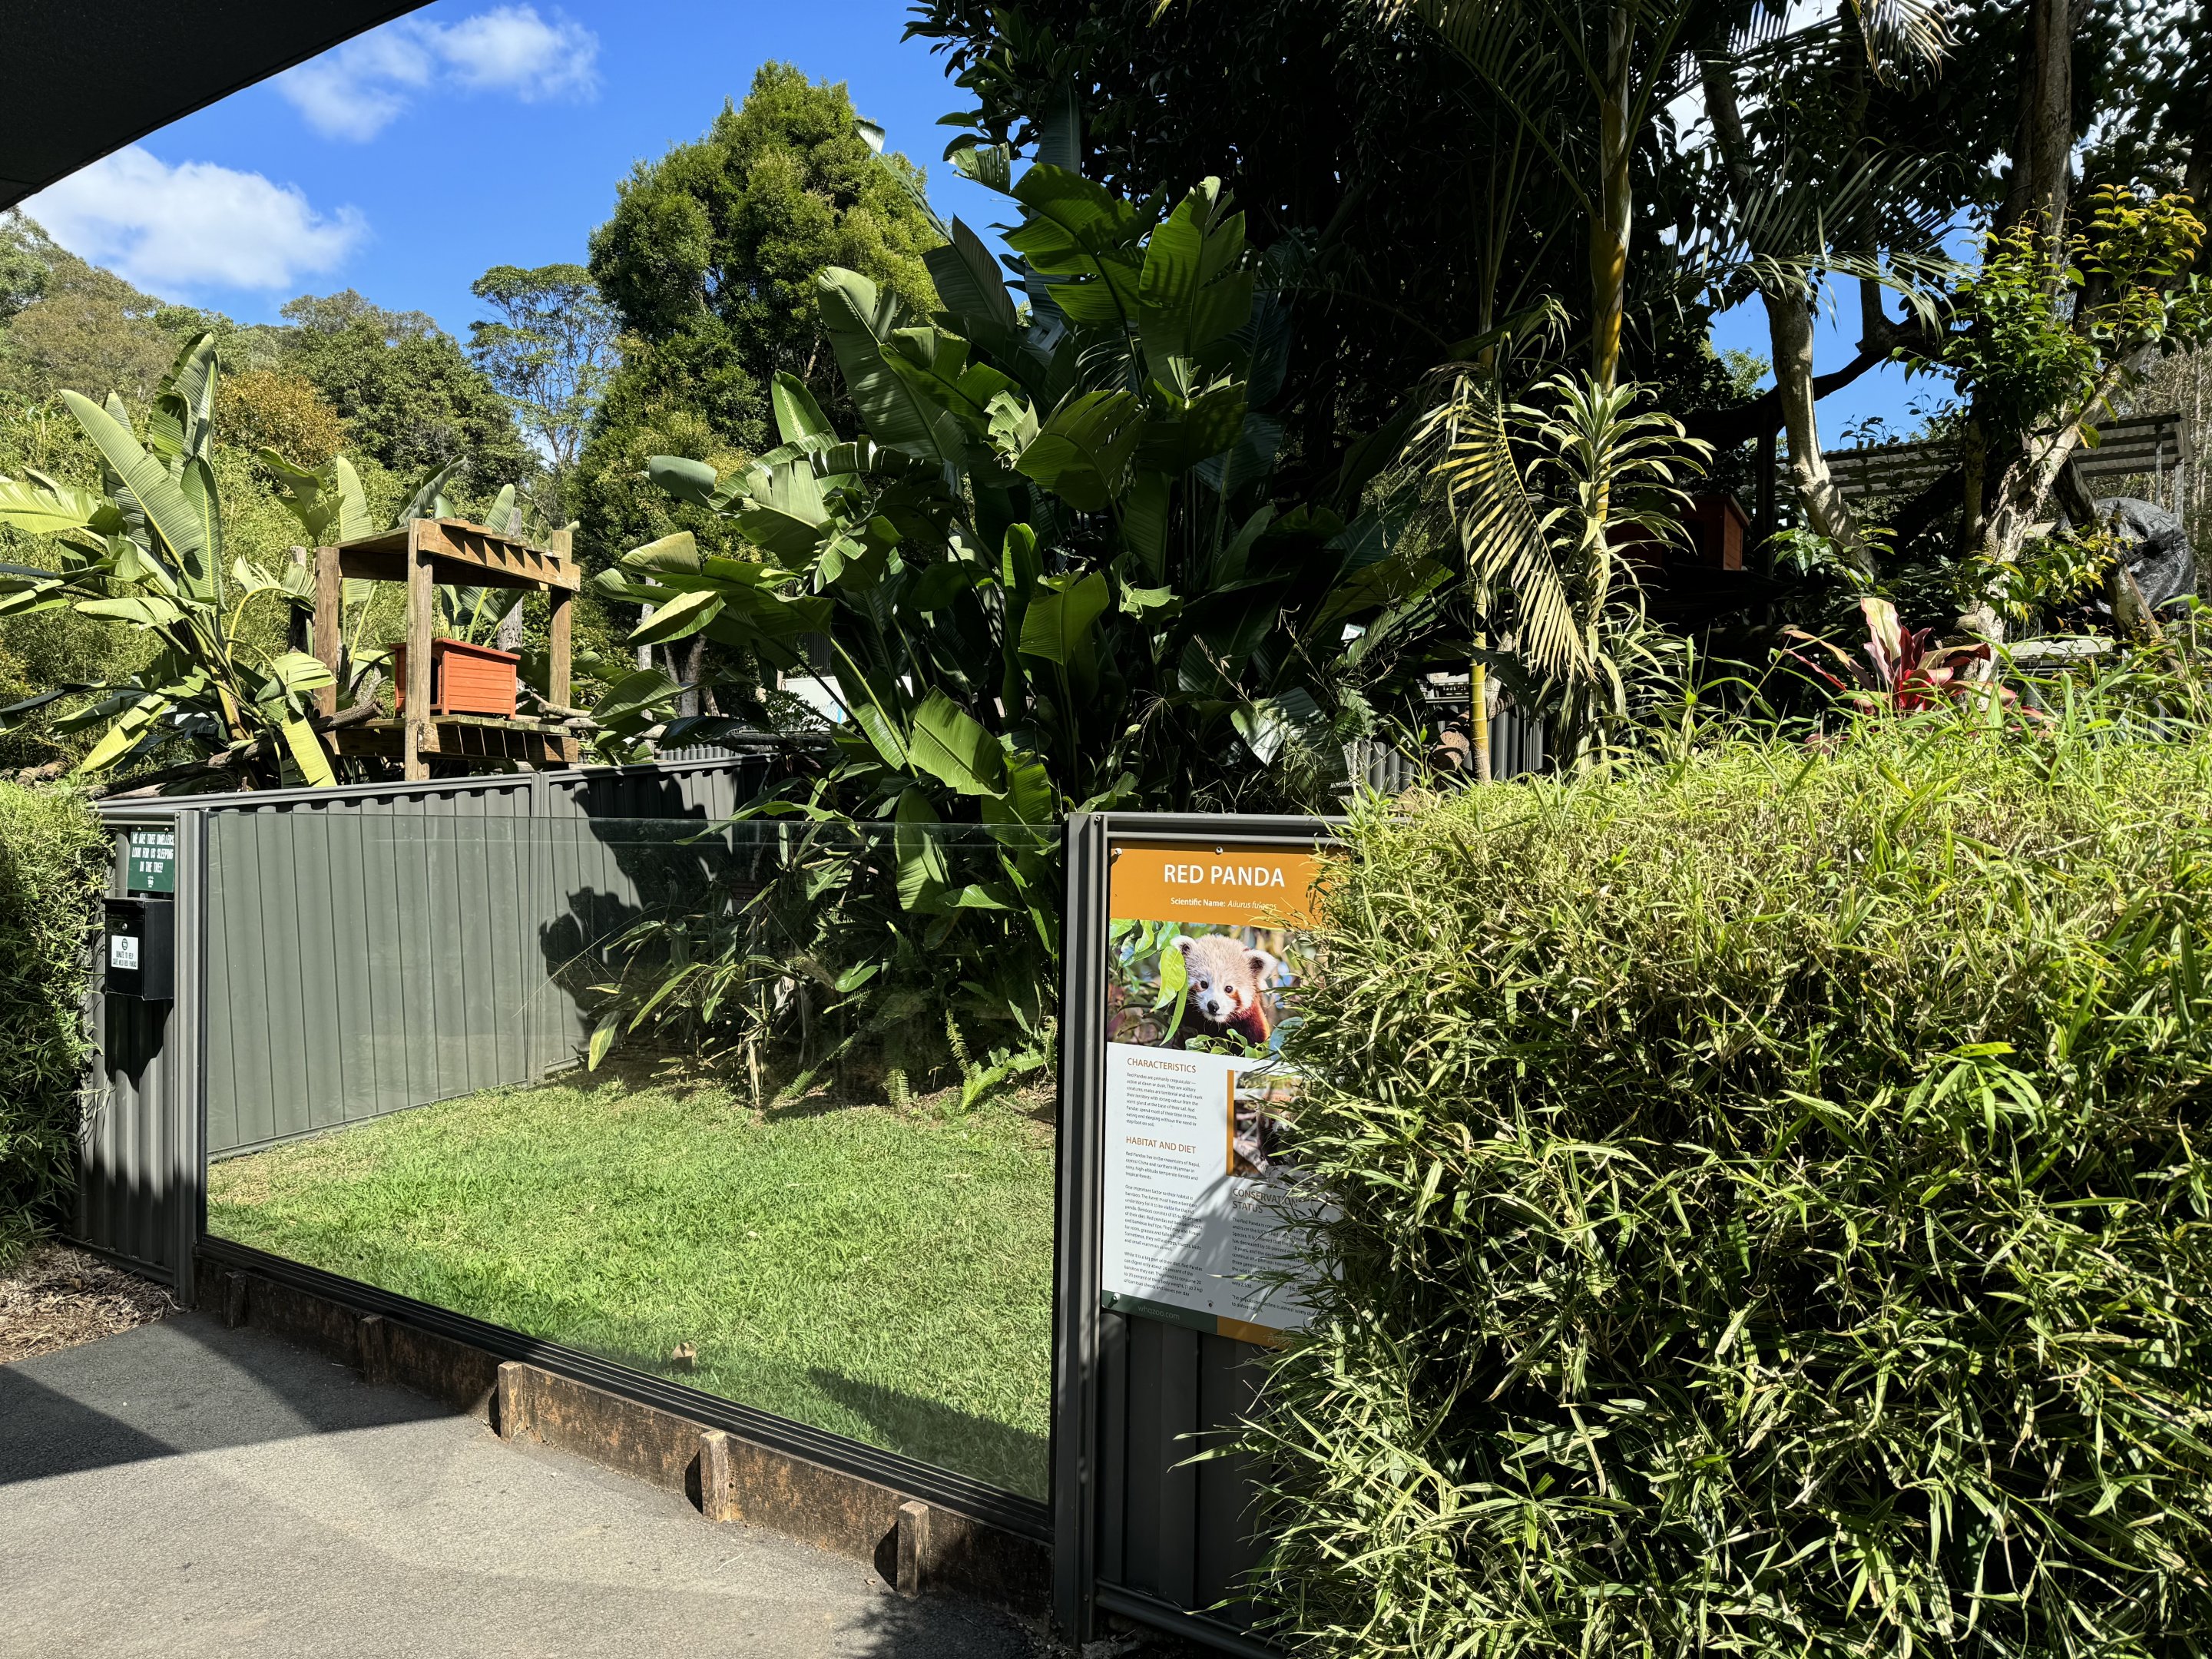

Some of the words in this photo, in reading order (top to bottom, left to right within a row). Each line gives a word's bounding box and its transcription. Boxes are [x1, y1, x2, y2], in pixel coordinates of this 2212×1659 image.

[132, 847, 141, 858] LOOK
[157, 848, 174, 859] SLEEPING
[1164, 864, 1204, 883] RED
[1210, 865, 1285, 887] PANDA
[1171, 897, 1202, 906] Scientific
[1203, 899, 1226, 907] Name:
[1227, 900, 1251, 909] Ailurus
[1127, 1058, 1196, 1073] CHARACTERISTICS
[1126, 1137, 1157, 1147] HABITAT
[1160, 1141, 1177, 1151] AND
[1179, 1144, 1196, 1154] DIET
[1233, 1200, 1263, 1214] STATUS
[1138, 1306, 1180, 1320] whqzoo.com
